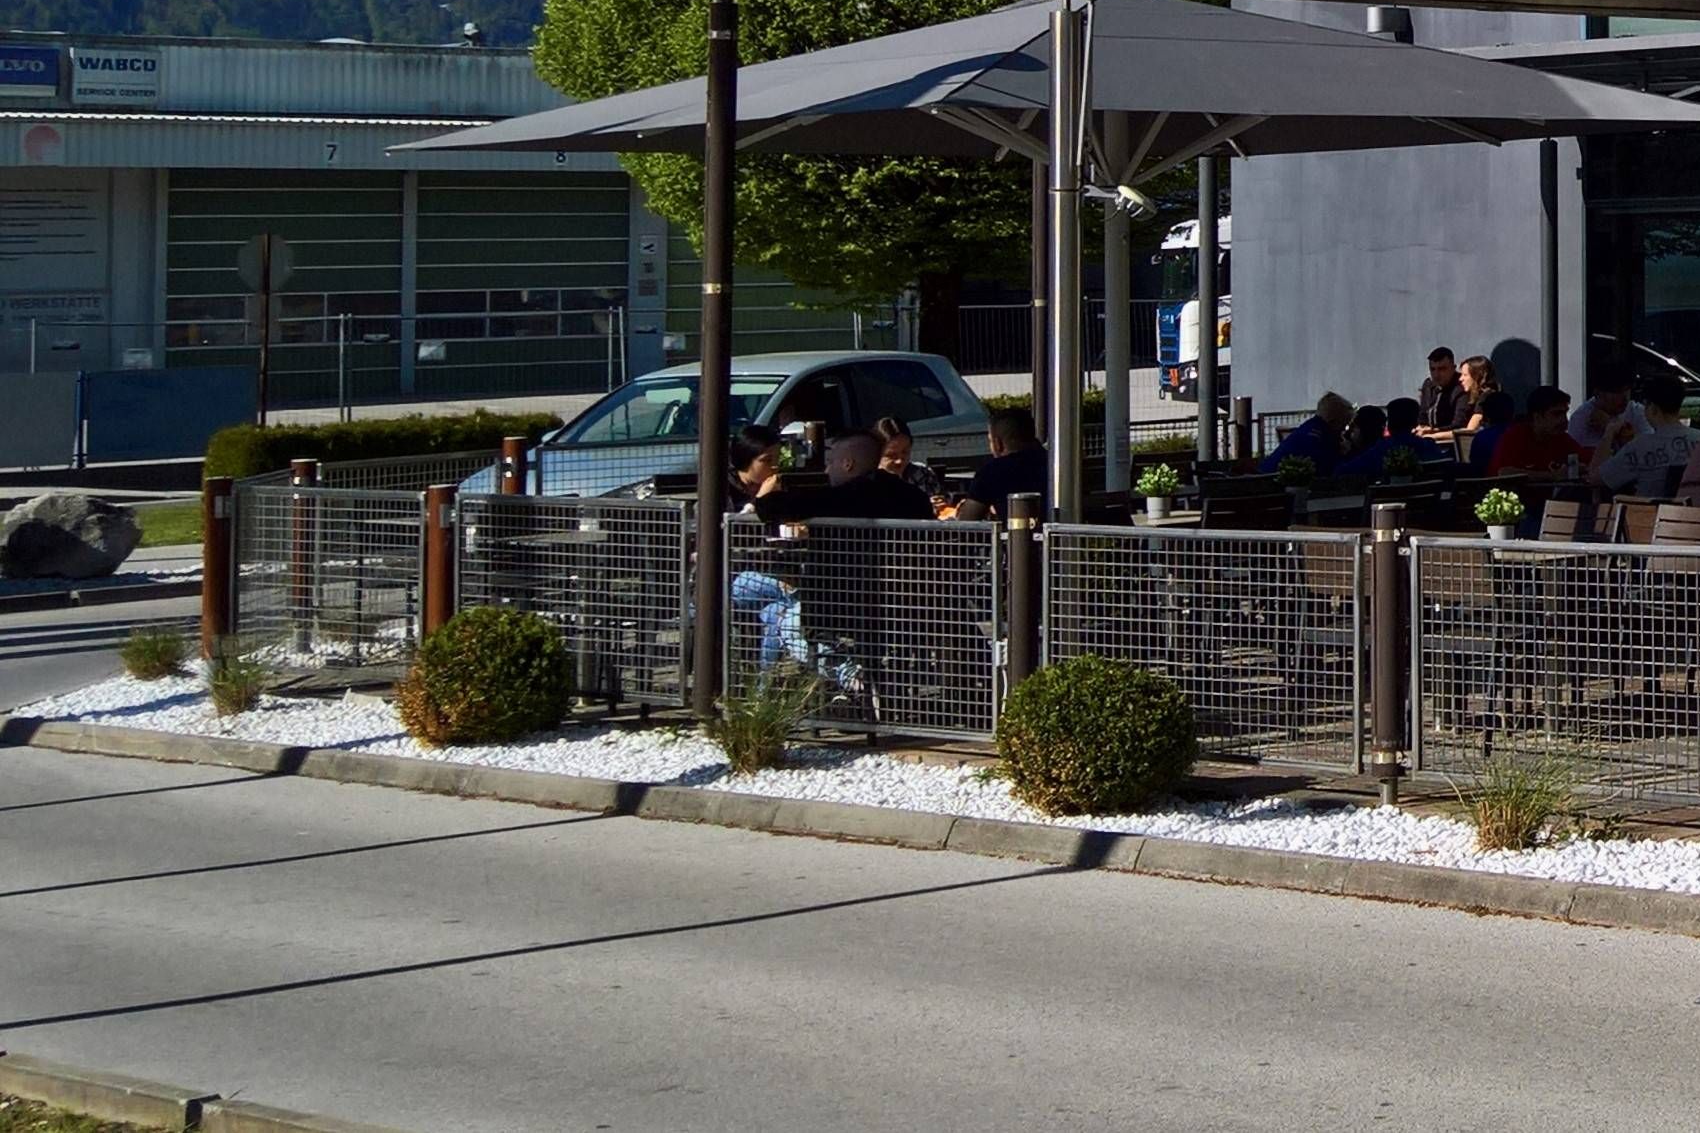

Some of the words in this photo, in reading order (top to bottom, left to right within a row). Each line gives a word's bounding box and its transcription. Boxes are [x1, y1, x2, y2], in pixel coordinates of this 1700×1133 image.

[79, 57, 156, 72] WABCO
[77, 88, 117, 96] SERVICE
[120, 89, 156, 97] CENTER
[326, 144, 337, 161] 7
